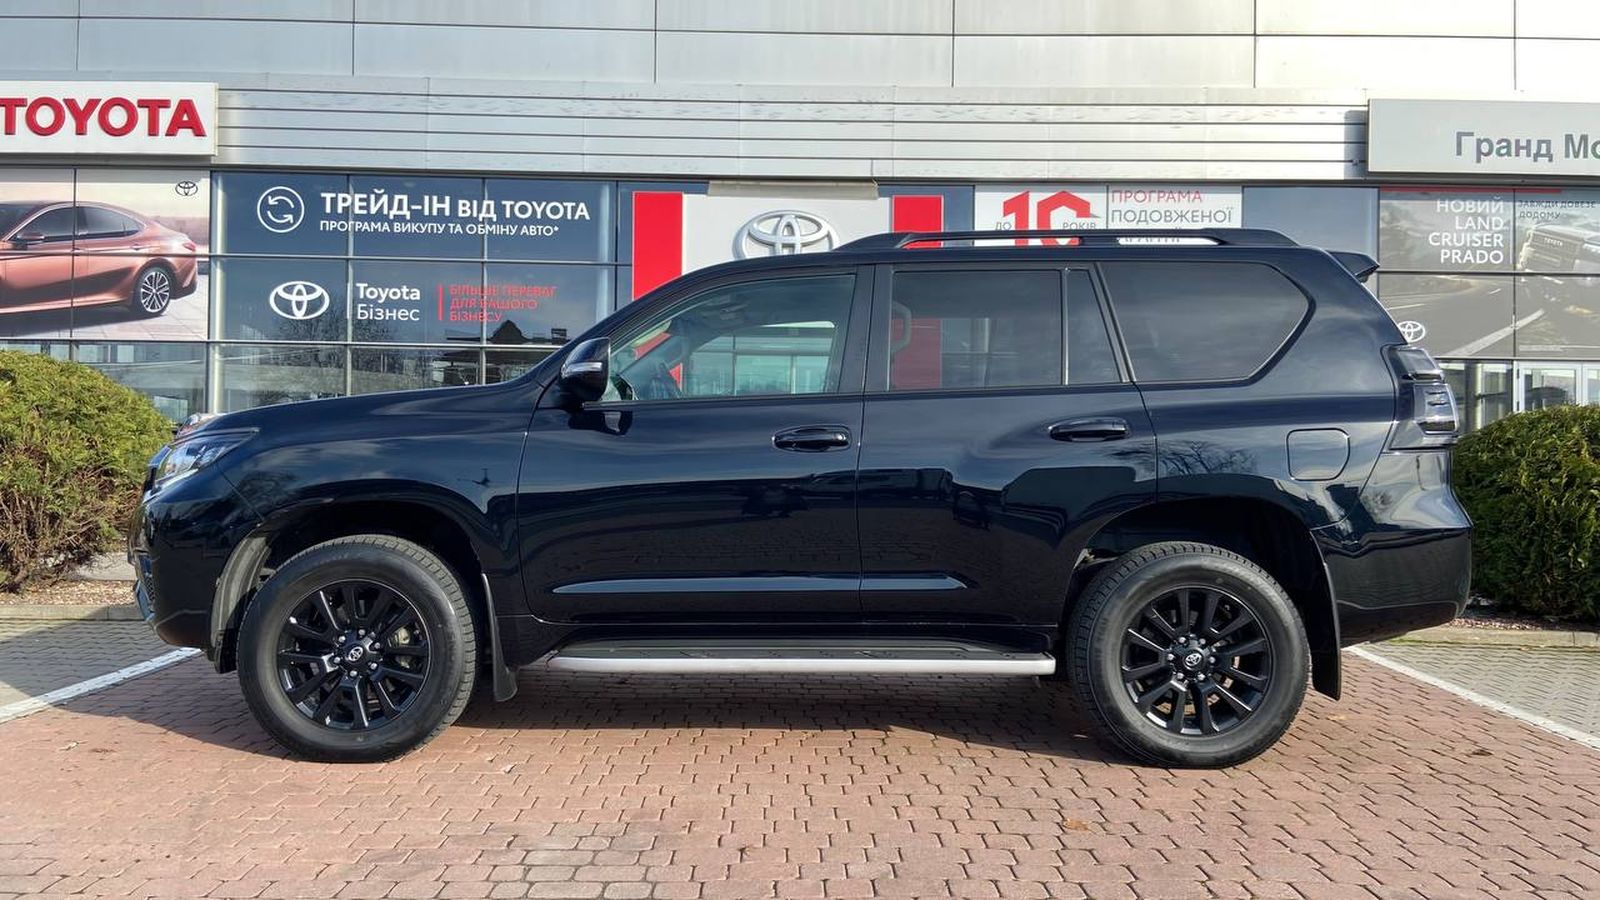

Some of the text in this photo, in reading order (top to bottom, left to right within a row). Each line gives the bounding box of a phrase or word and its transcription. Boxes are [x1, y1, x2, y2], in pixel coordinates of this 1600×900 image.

[0, 97, 207, 137] TOYOTA
[1456, 131, 1553, 163] Гранд
[320, 188, 591, 222] ТРЕЙД-ІН ВІД TOYOTA
[1111, 190, 1202, 203] ПРОГРАМА
[1436, 196, 1504, 214] НОВИЙ
[1111, 207, 1234, 225] ПОДОВЖЕНОЇ
[1455, 216, 1504, 231] LAND
[320, 220, 391, 233] ПРОГРАМА
[393, 222, 446, 234] ВИКУПУ
[448, 223, 463, 234] ТА
[466, 223, 518, 235] ОБМІНУ
[1428, 231, 1505, 248] CRUISER
[1440, 248, 1504, 265] PRADO
[355, 283, 421, 304] Toyota
[357, 303, 420, 321] Бізнес
[450, 311, 502, 322] БІЗНЕСУ
